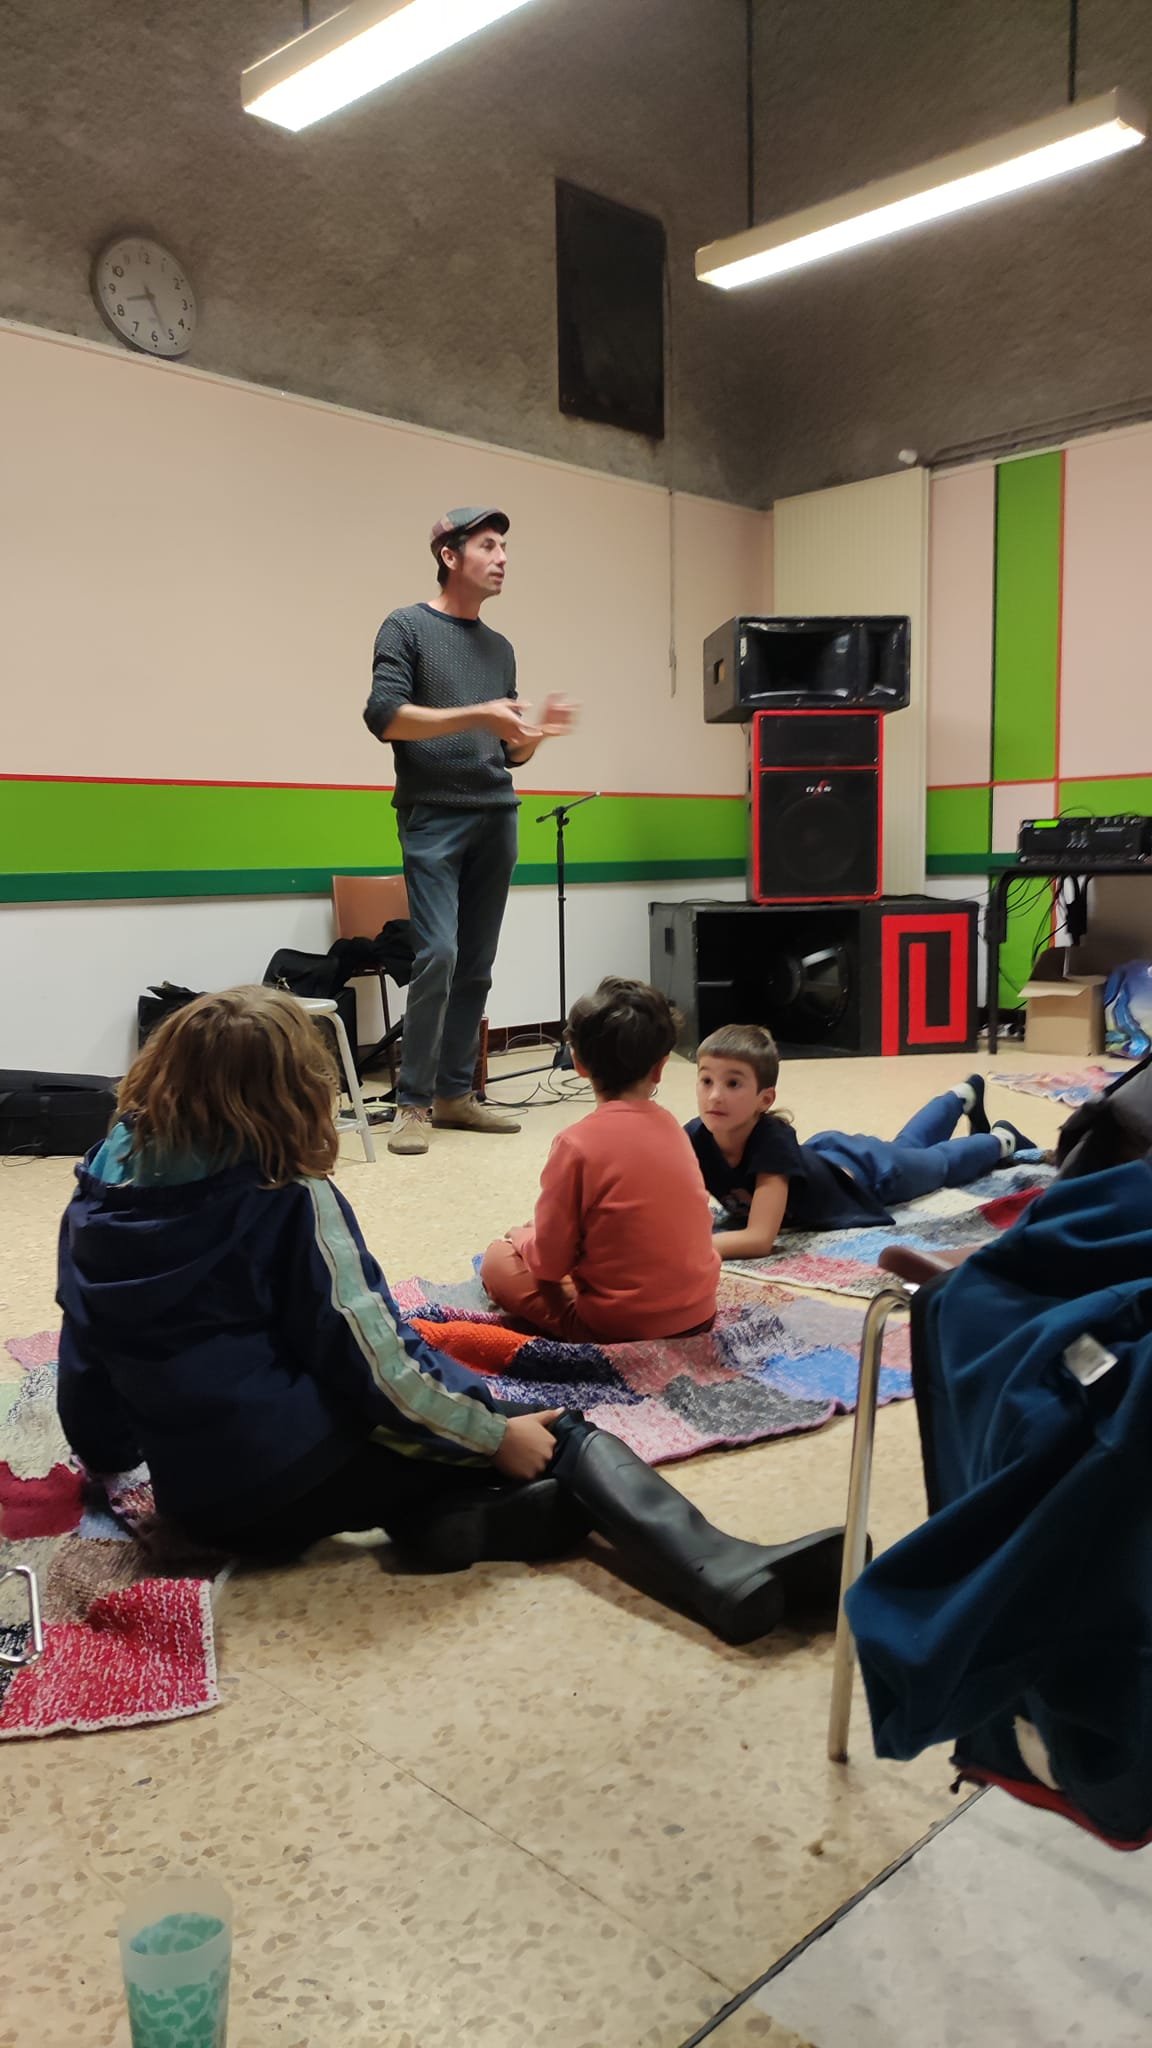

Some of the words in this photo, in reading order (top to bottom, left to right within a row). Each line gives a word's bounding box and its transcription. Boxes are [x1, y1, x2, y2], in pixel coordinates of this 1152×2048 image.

[109, 282, 116, 294] 9
[173, 276, 181, 290] 2
[116, 303, 125, 317] 8
[181, 298, 188, 311] 3
[132, 321, 140, 333] 7
[177, 317, 185, 329] 4
[151, 330, 158, 343] 6
[168, 328, 175, 341] 5
